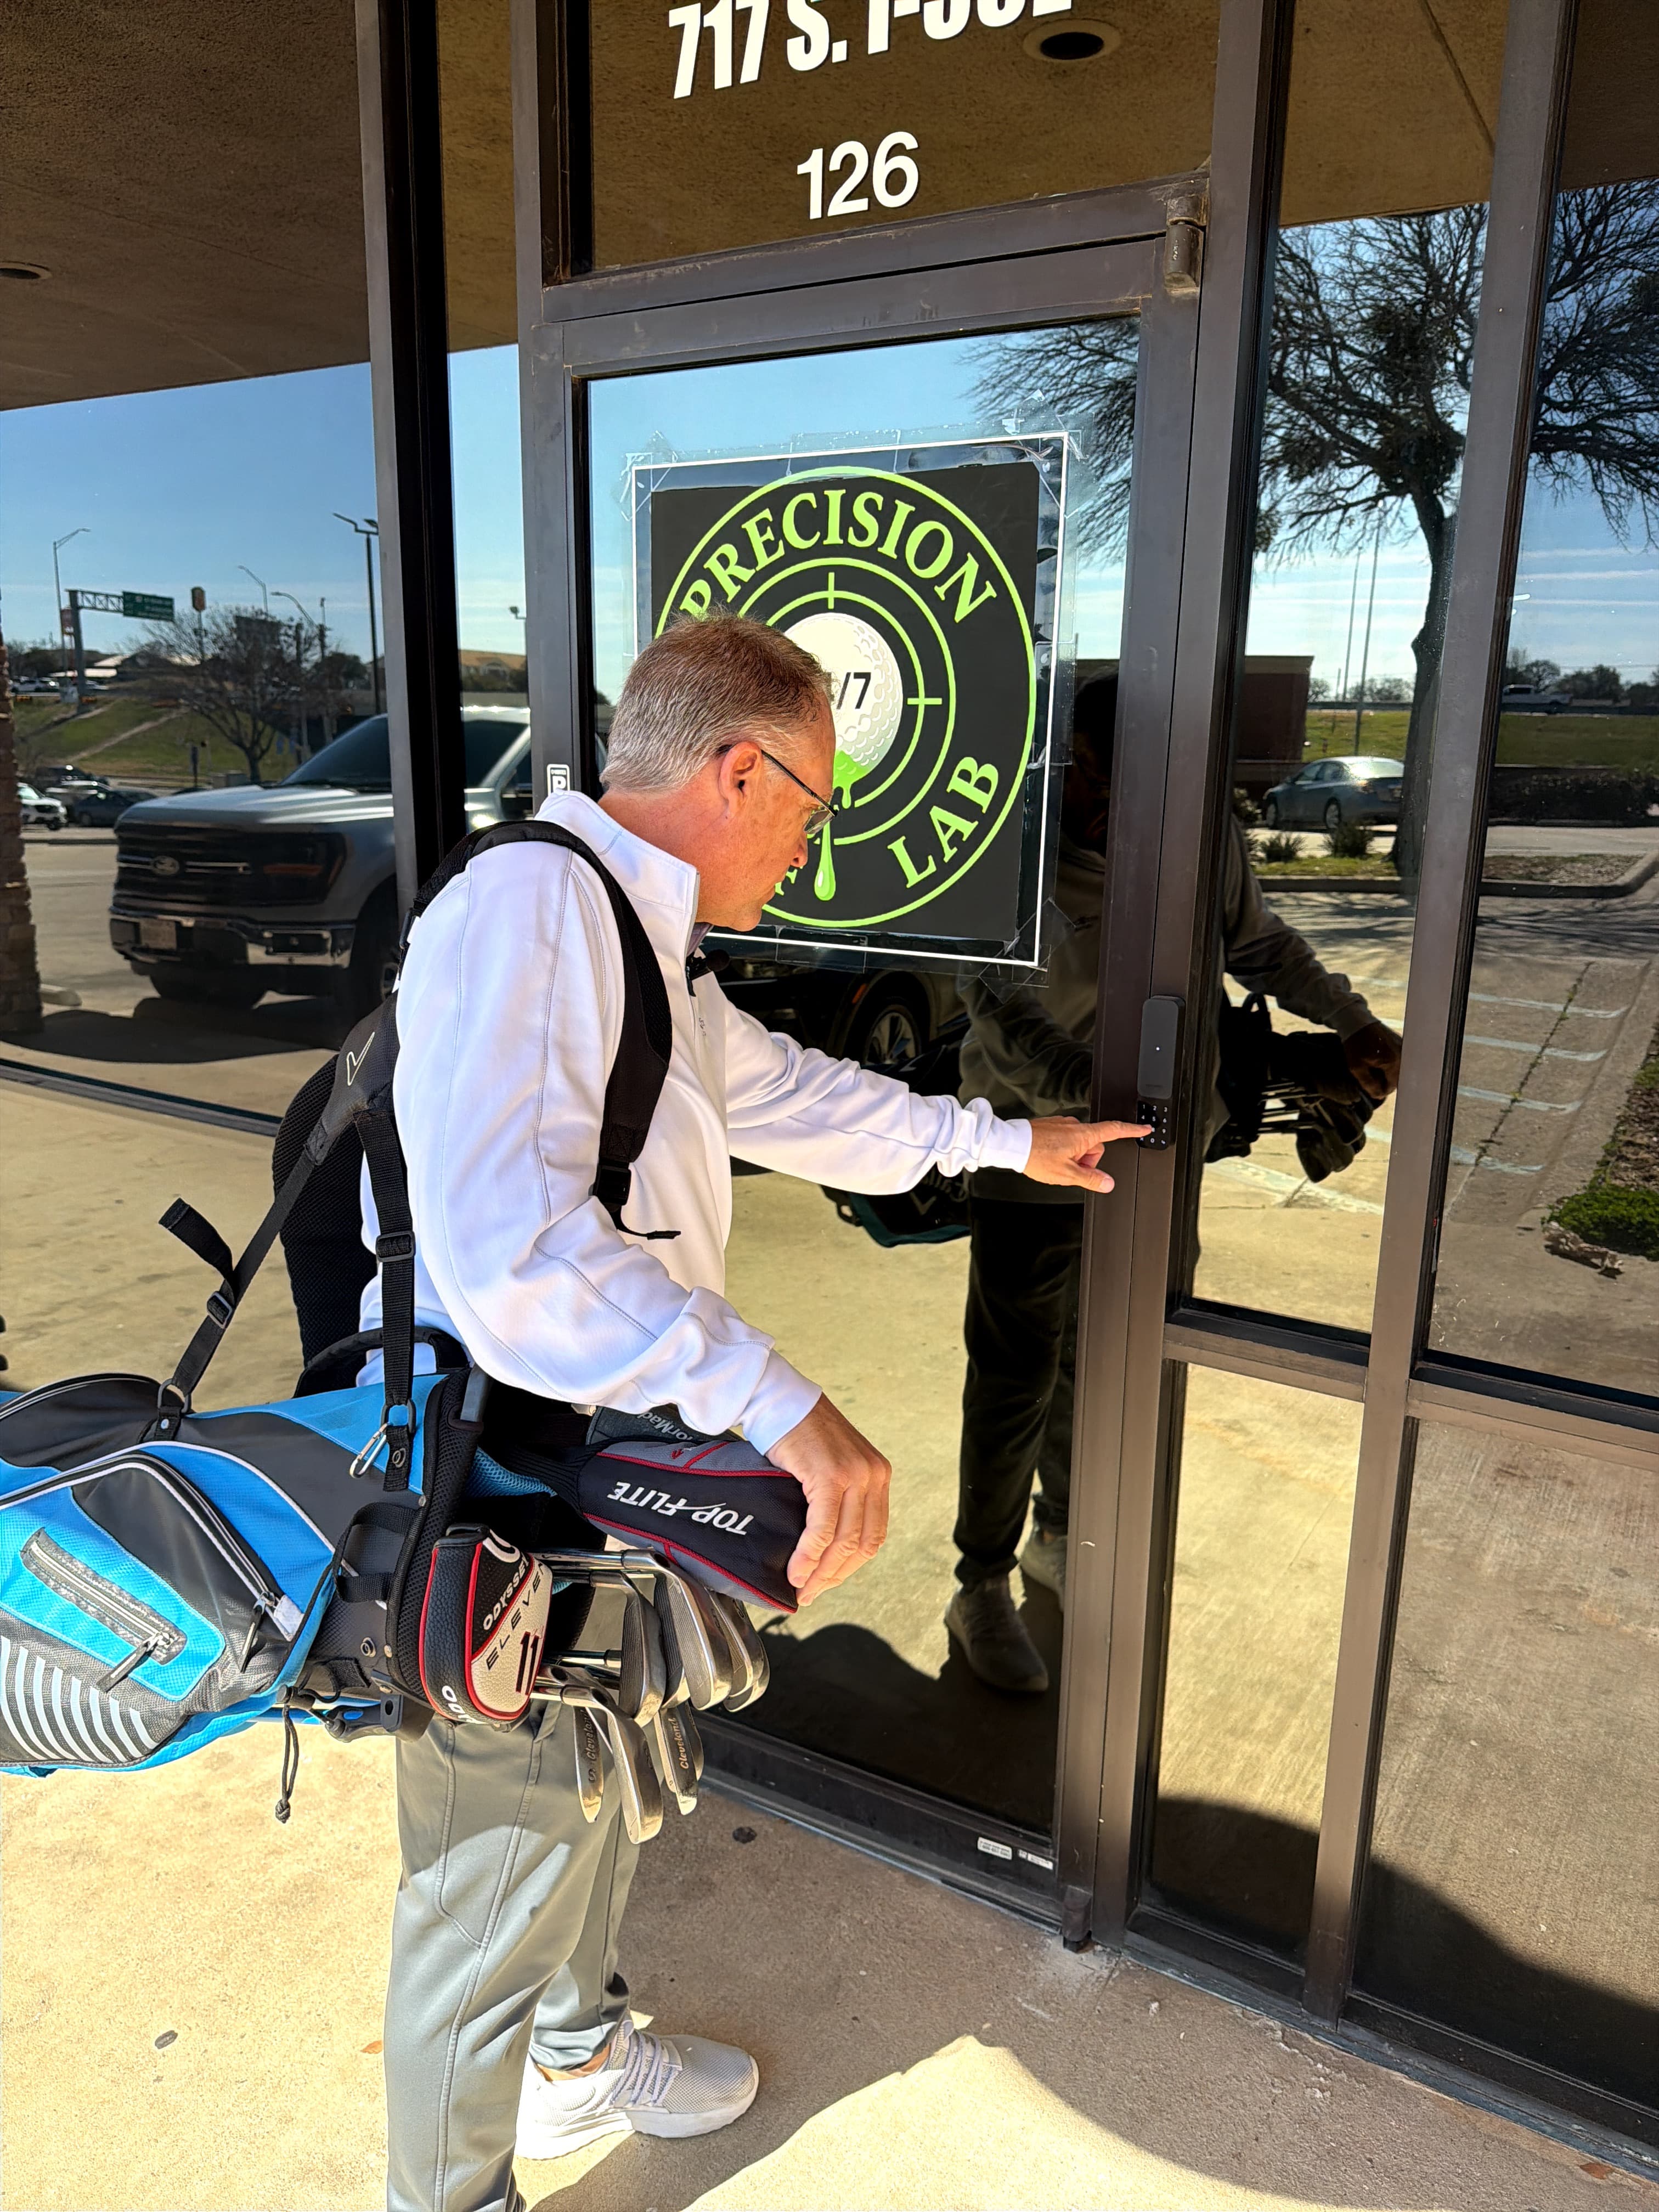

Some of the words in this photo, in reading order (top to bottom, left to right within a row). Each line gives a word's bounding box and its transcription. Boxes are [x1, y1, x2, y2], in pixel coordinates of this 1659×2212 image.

[669, 0, 769, 99] 717
[786, 0, 847, 71] S.
[797, 132, 919, 219] 126
[679, 489, 997, 623] PRECISION
[888, 756, 998, 888] LAB
[668, 1717, 689, 1769] Cleveland
